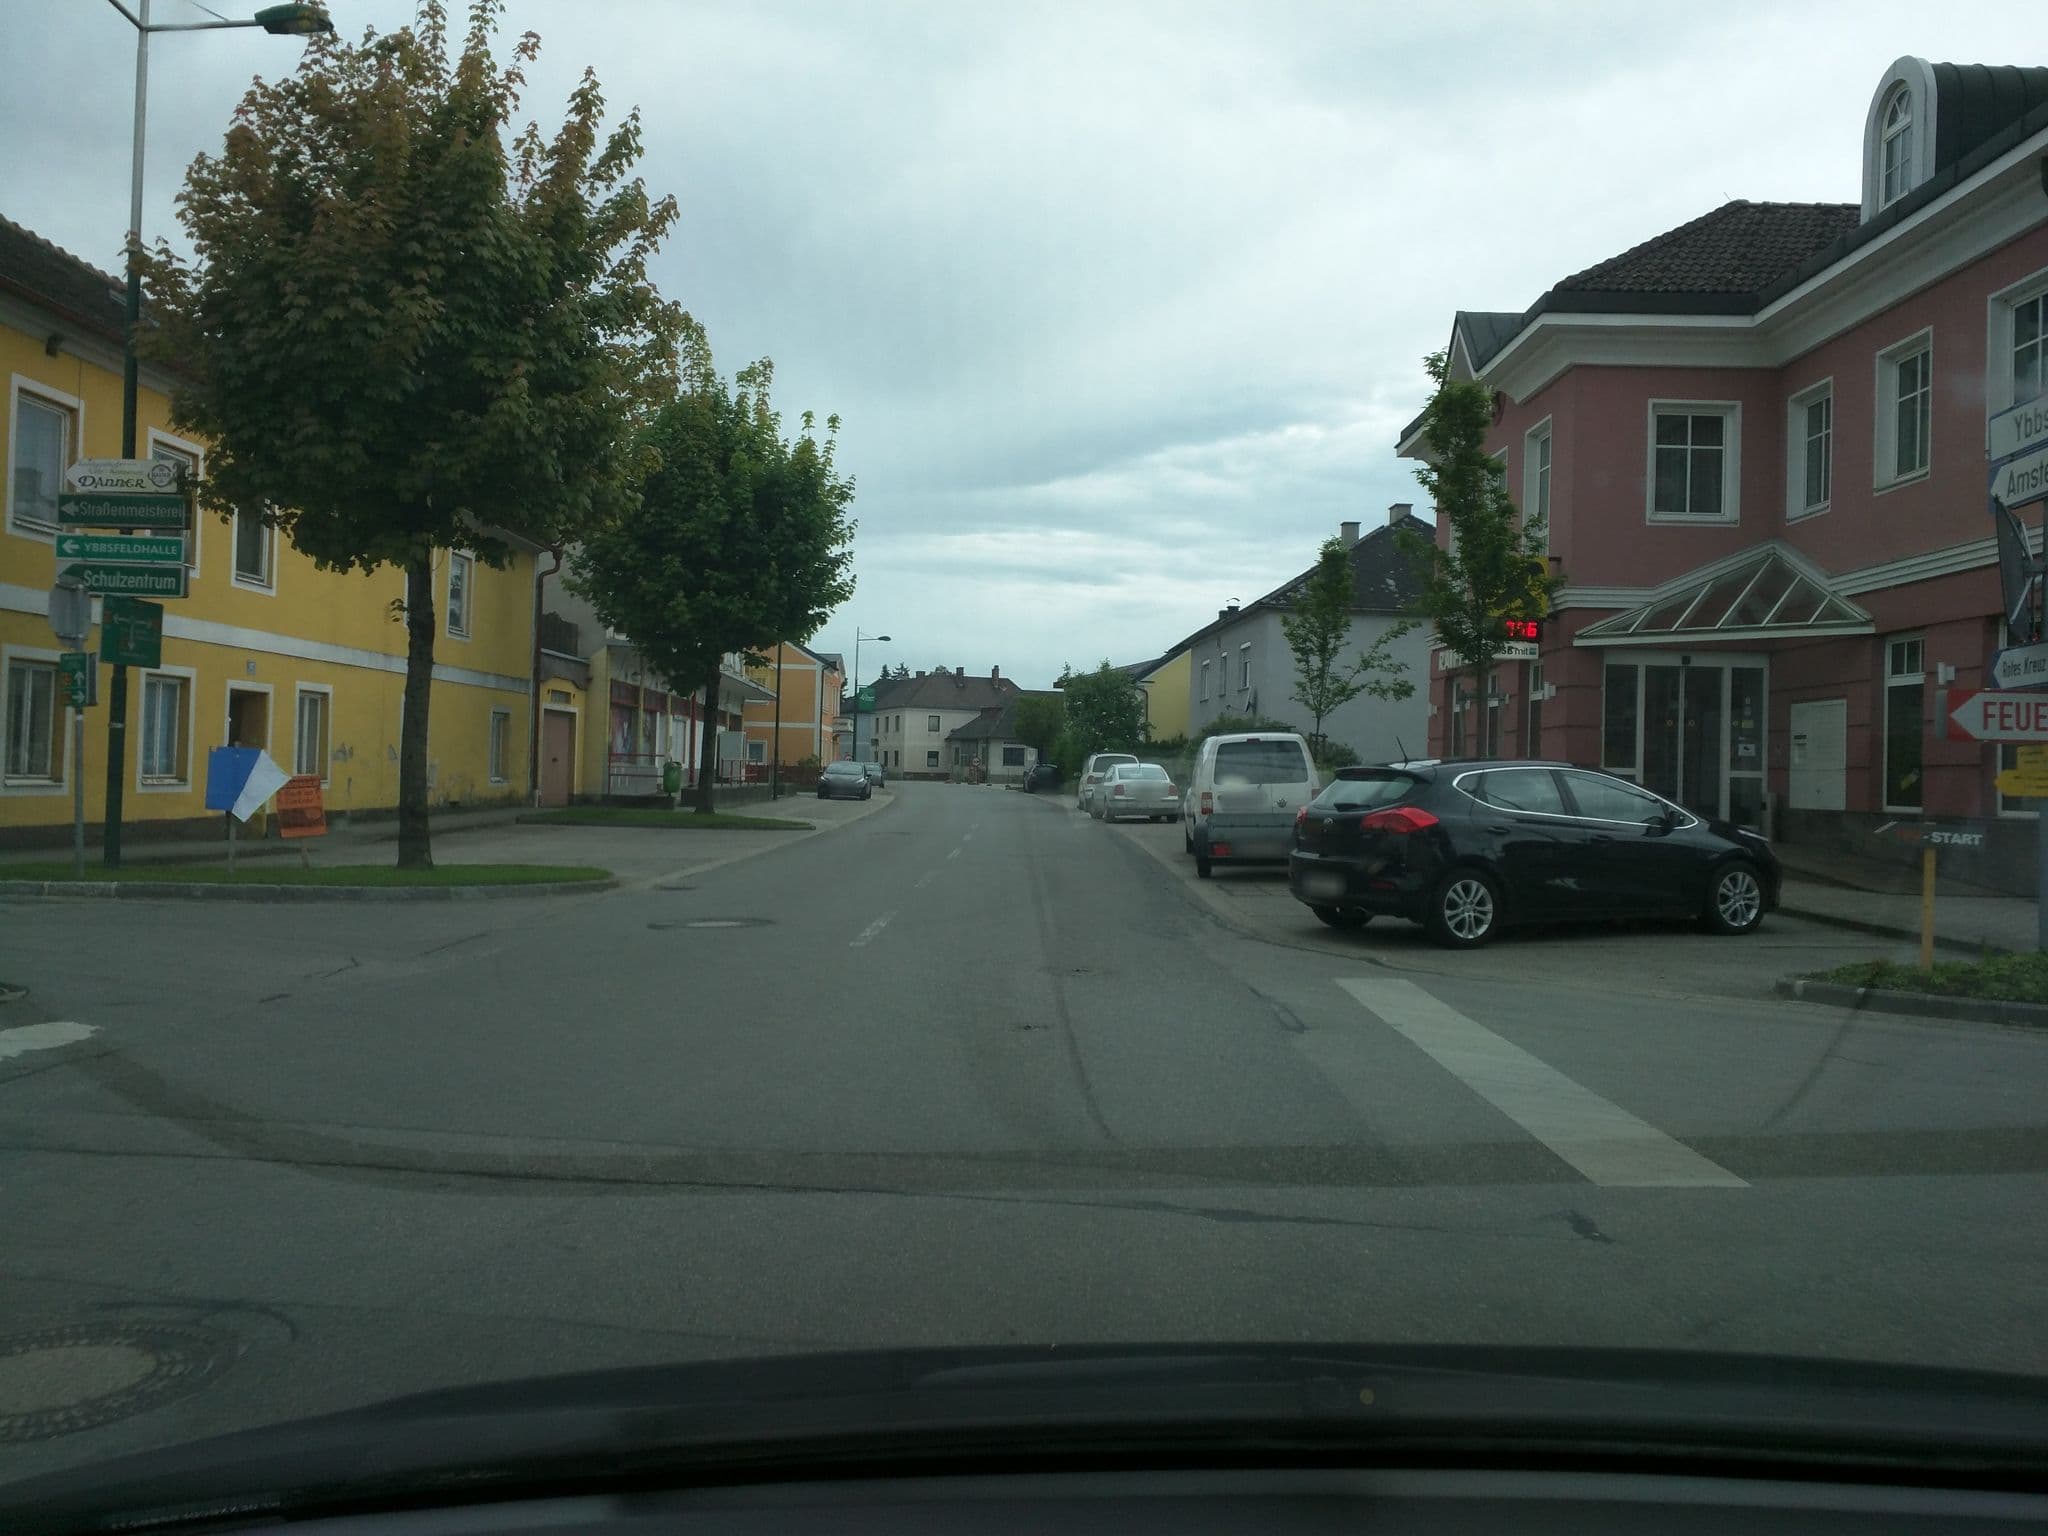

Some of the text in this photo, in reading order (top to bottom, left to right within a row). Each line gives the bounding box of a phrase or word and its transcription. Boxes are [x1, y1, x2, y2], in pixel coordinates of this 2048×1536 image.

[80, 501, 183, 518] Straßenmeisterei
[84, 542, 177, 555] YBBSFELDHALLE
[83, 569, 176, 590] Schulzentrum
[2024, 656, 2047, 675] Kreuz
[1982, 700, 2048, 731] FEUE
